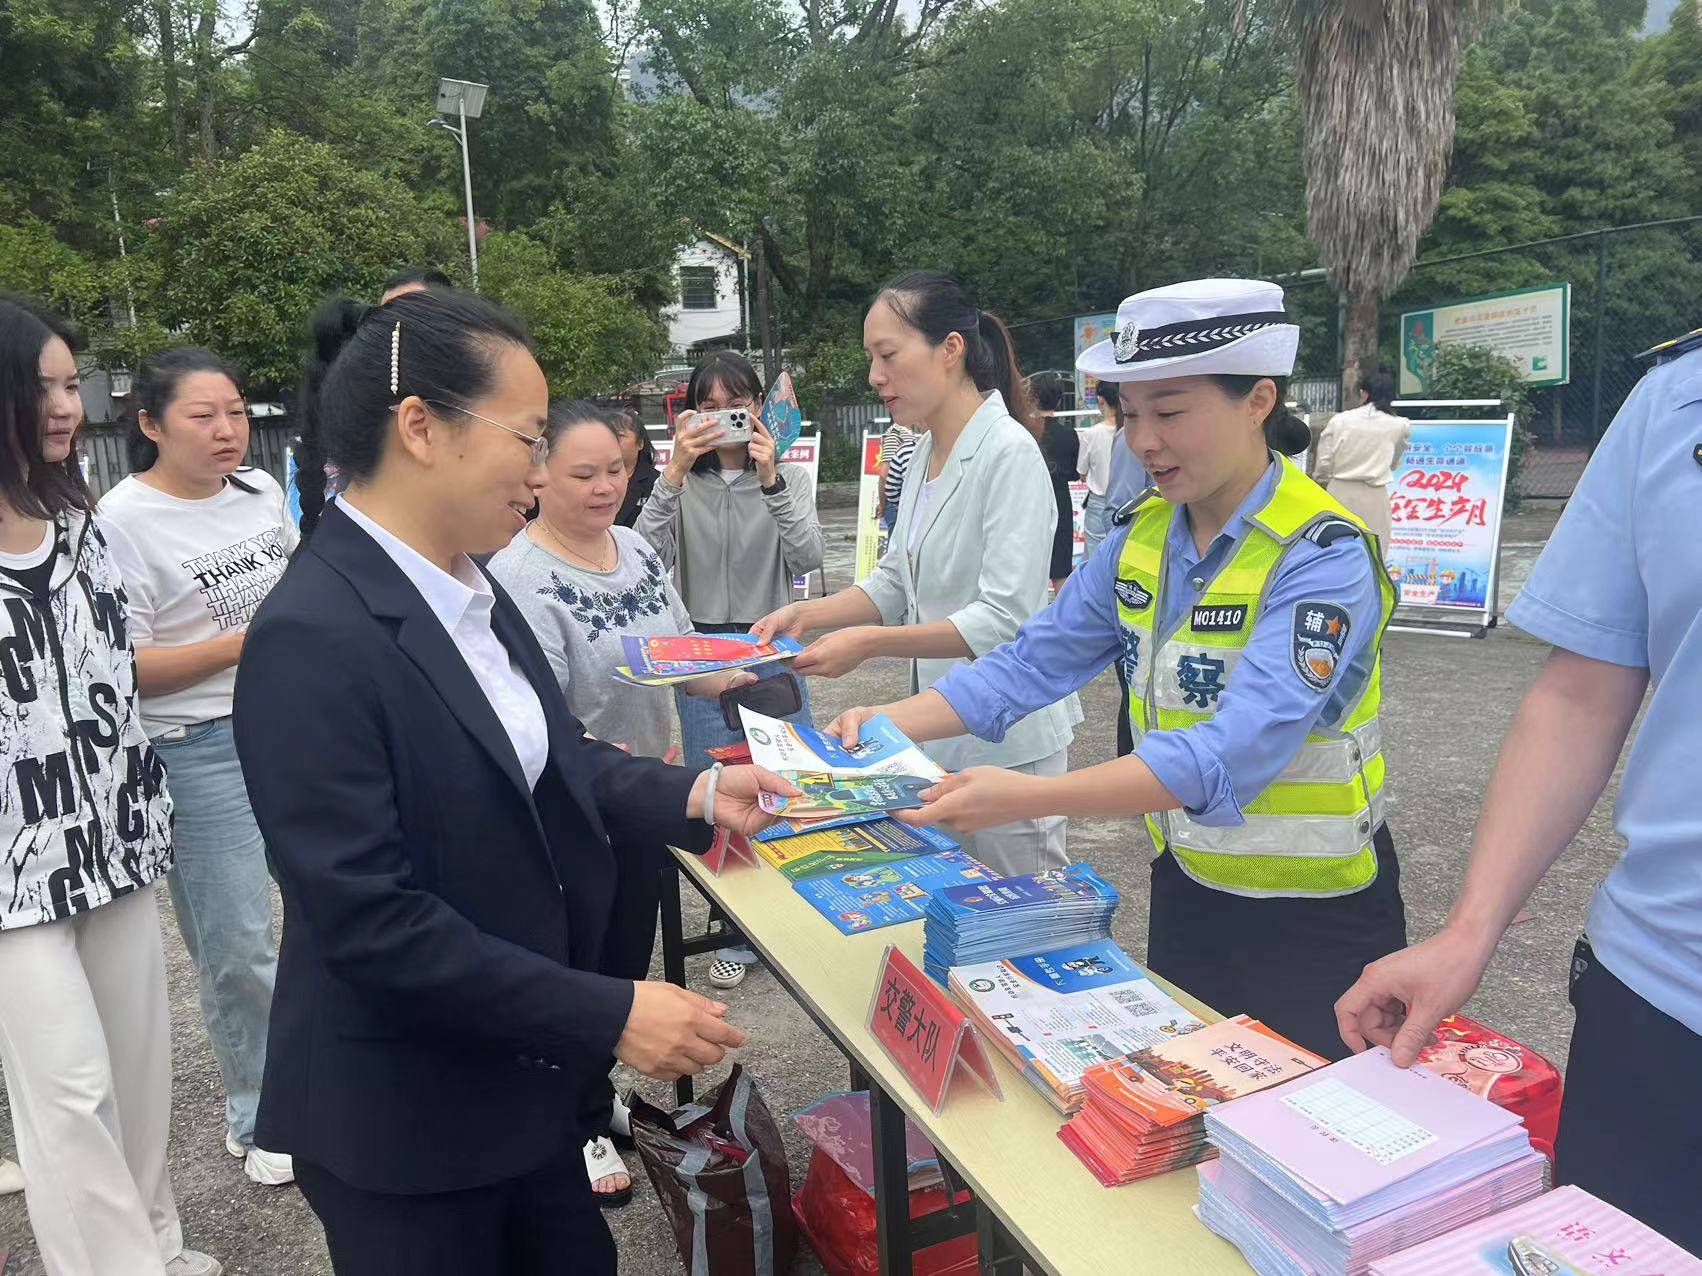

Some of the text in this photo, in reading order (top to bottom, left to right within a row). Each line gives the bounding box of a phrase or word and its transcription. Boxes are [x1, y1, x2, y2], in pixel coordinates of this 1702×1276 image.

[1399, 469, 1469, 493] 2024
[181, 540, 252, 576] THANK
[193, 542, 287, 588] THANK YO
[1304, 609, 1325, 633] 辅
[1176, 652, 1226, 708] 察
[88, 682, 119, 748] S
[14, 750, 75, 825] M
[880, 977, 941, 1072] 交警大队
[1209, 1048, 1267, 1080] 平安回家
[1224, 1041, 1283, 1074] 文明守法
